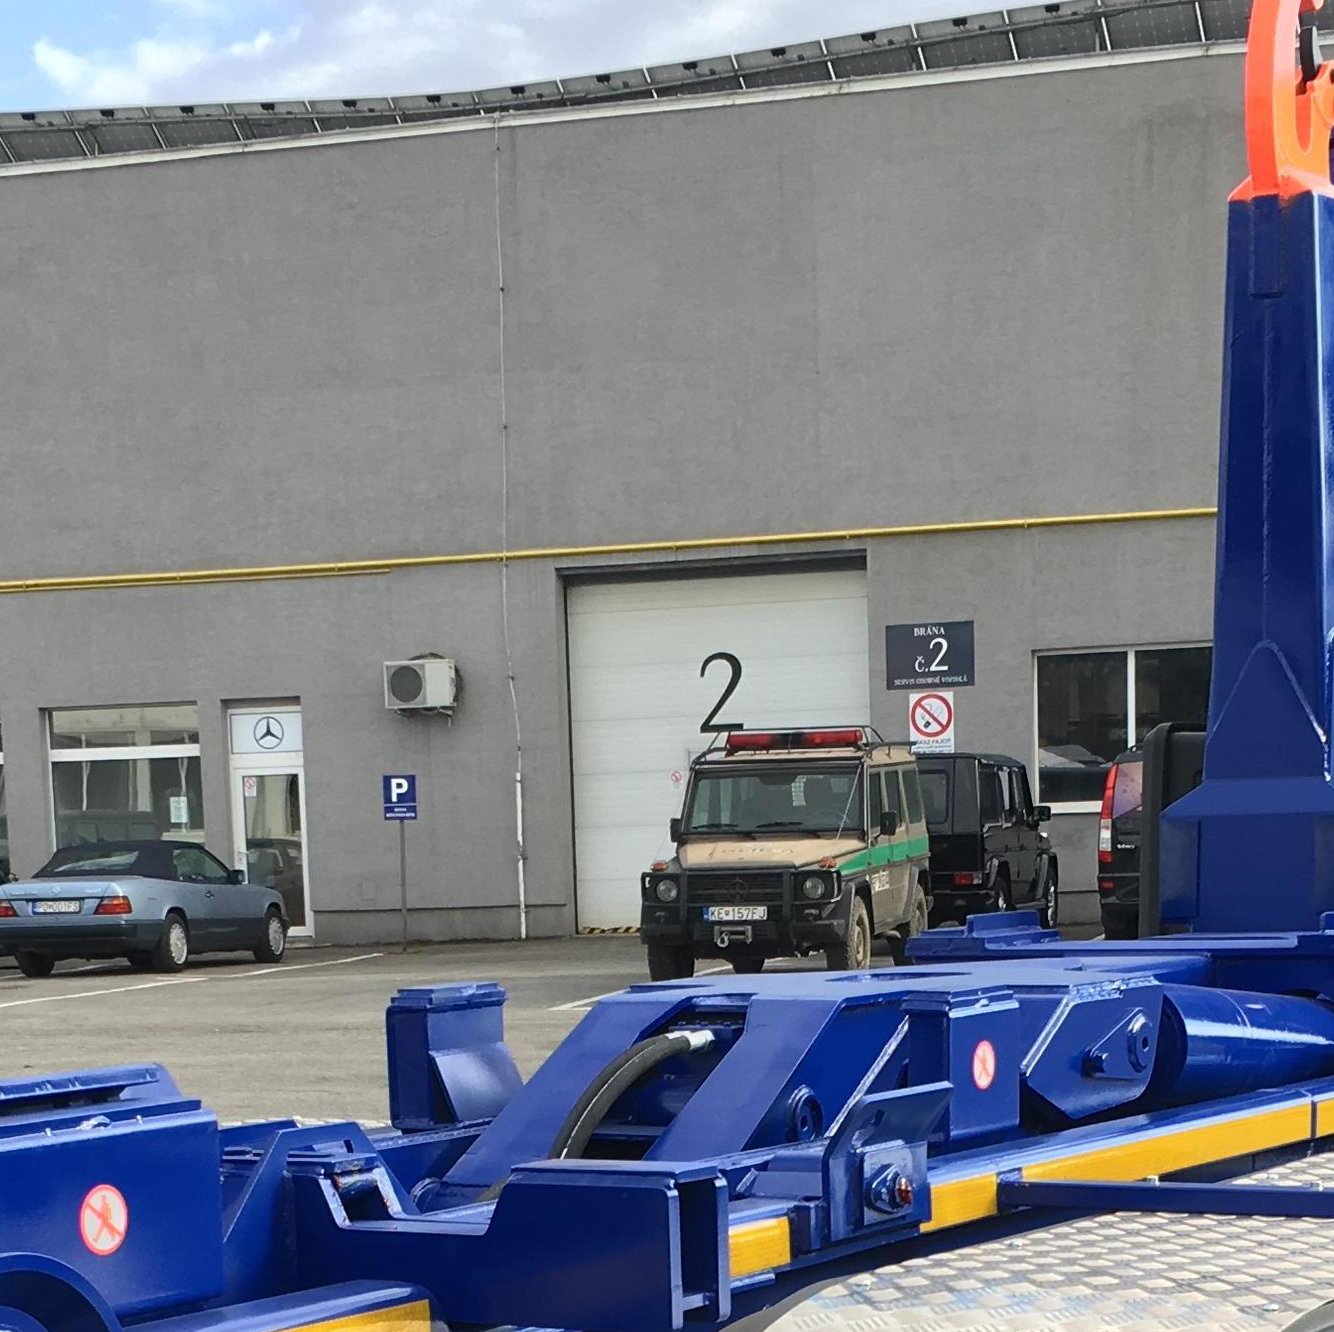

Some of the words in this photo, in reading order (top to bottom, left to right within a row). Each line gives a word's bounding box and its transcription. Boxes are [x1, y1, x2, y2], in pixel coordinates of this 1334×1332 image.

[914, 625, 946, 637] BRÁNA
[699, 651, 743, 733] 2
[390, 778, 409, 802] P
